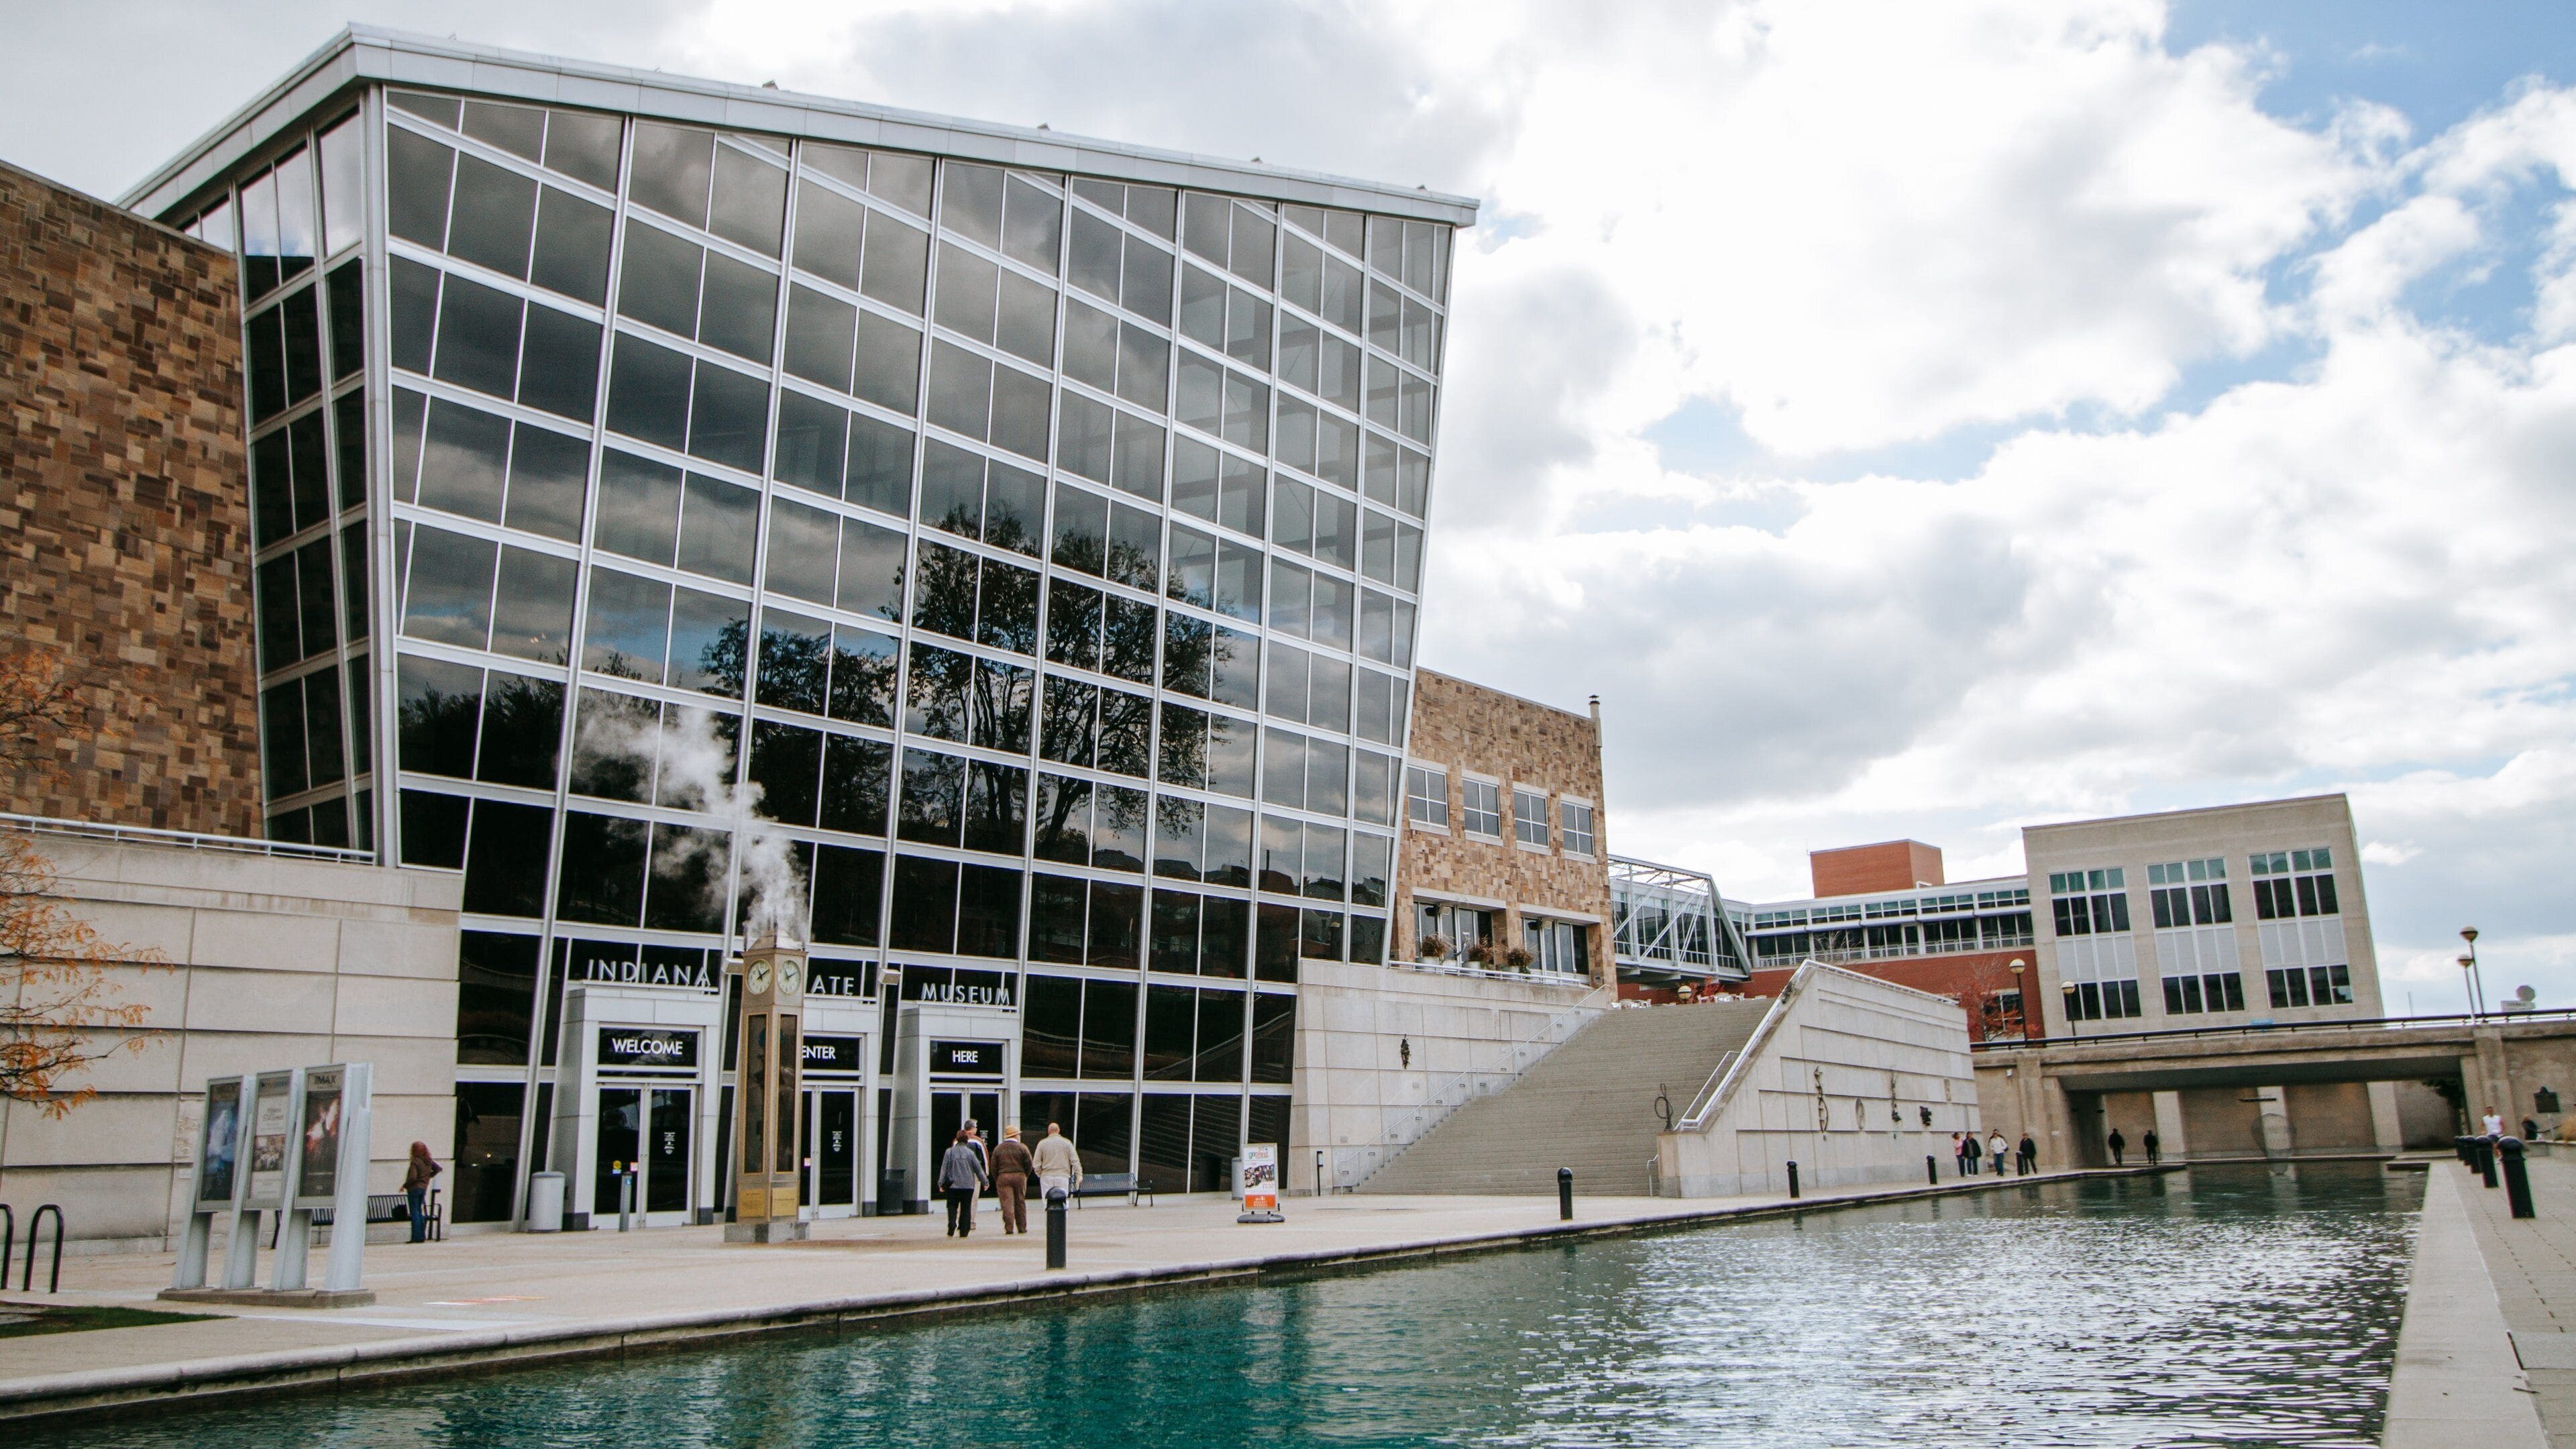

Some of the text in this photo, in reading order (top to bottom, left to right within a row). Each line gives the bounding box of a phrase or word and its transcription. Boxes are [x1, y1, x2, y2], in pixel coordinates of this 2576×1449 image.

[587, 959, 1010, 1006] INDIANA ATE MUSEUM
[612, 1037, 684, 1055] WELCOME
[952, 1050, 978, 1063] HERE
[314, 1075, 337, 1085] IMAX
